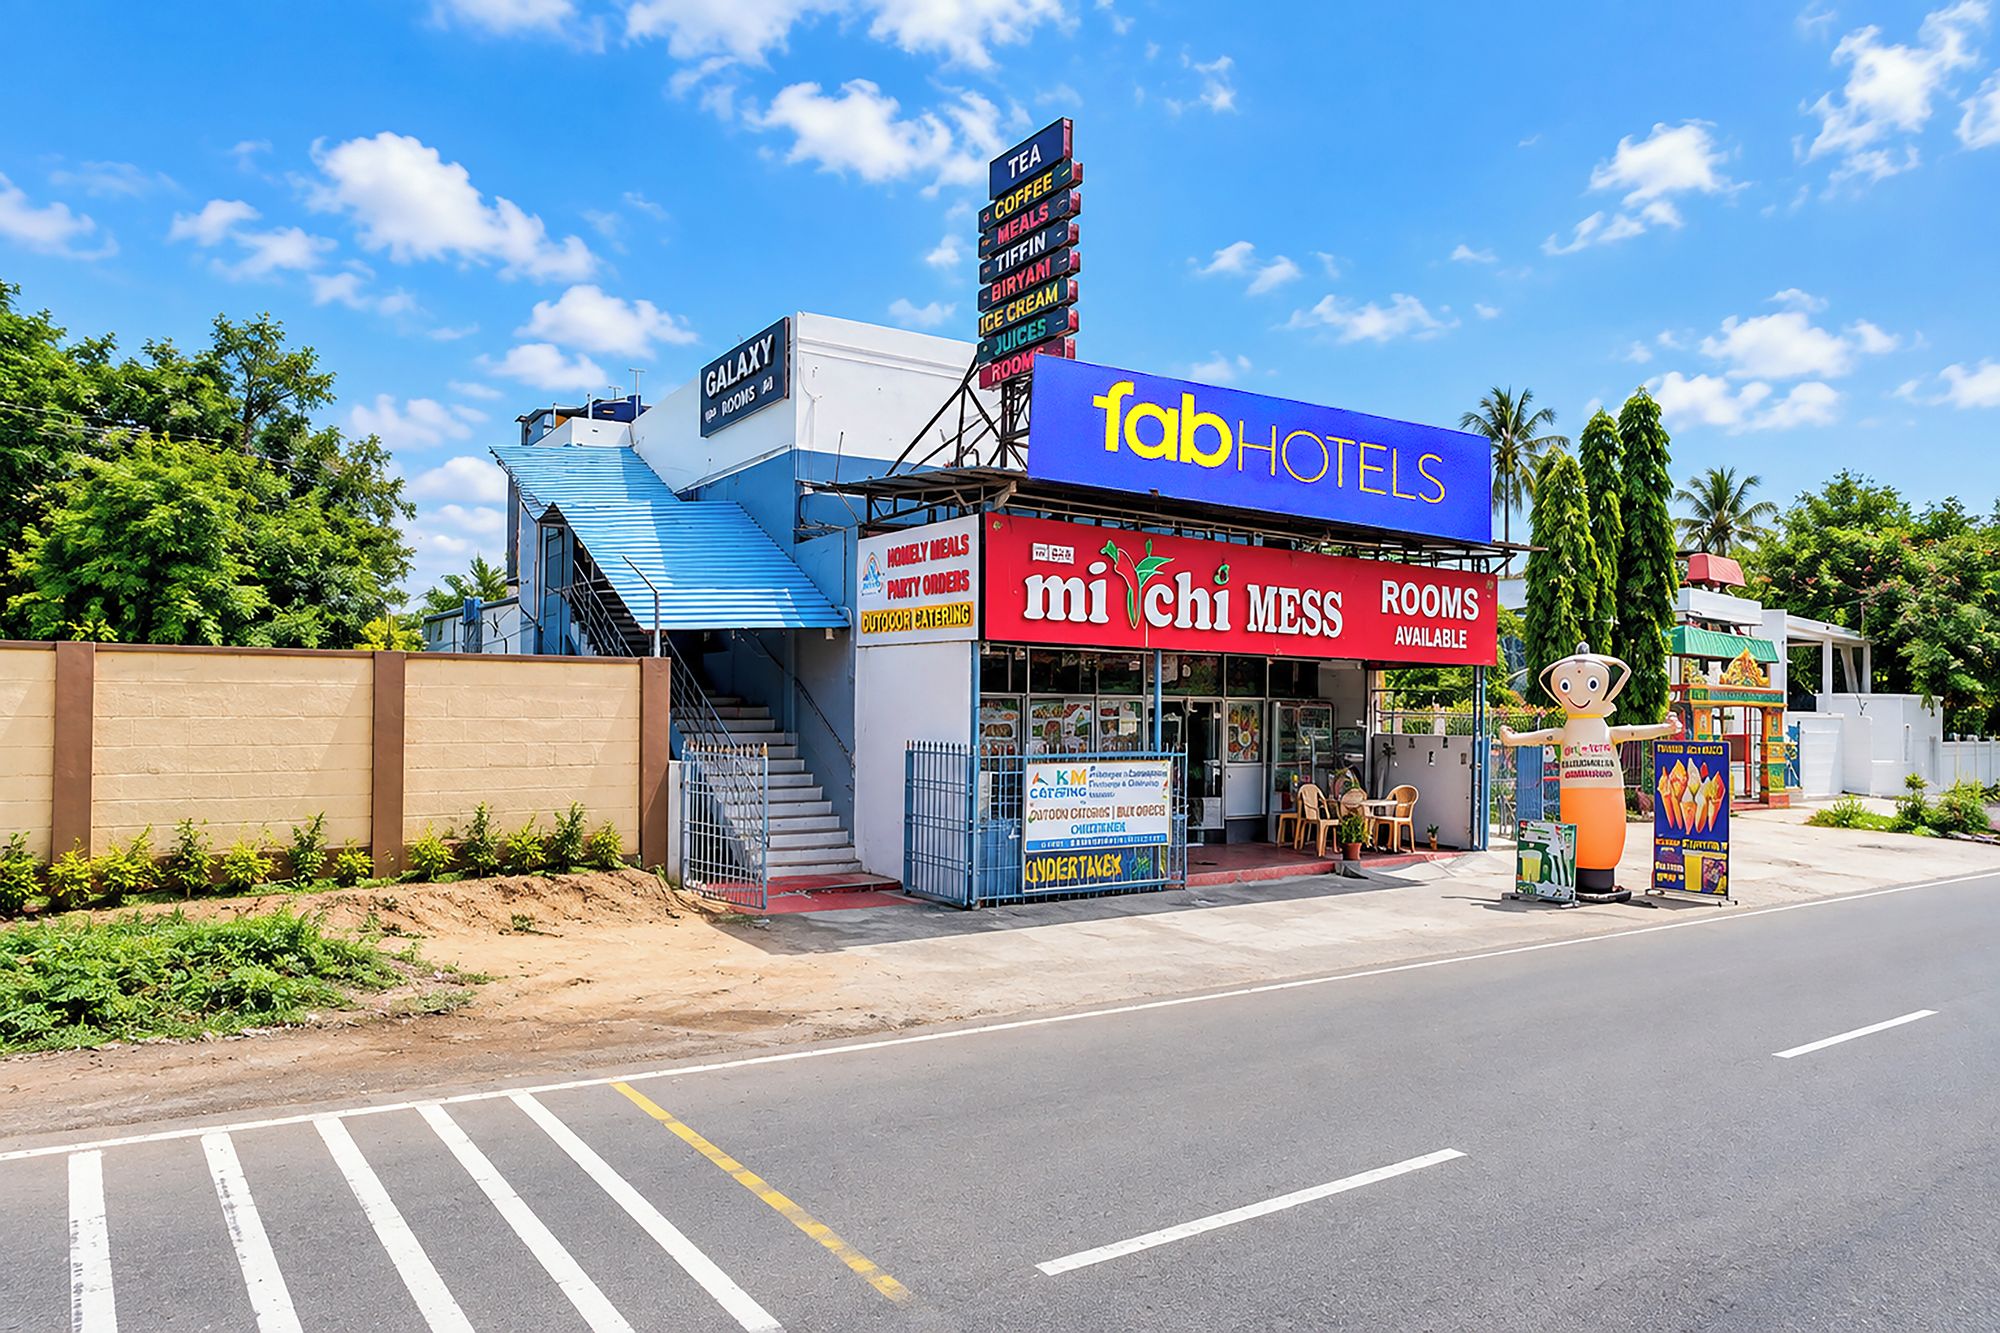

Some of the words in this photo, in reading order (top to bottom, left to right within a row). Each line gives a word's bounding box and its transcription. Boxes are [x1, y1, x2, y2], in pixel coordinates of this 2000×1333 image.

[1008, 143, 1042, 178] TEA
[994, 172, 1053, 219] COFFEE
[997, 203, 1049, 244] MEALS
[995, 231, 1047, 272] TIFFIN
[991, 258, 1051, 302] BIRYANI
[979, 308, 1004, 336] ICE
[1006, 283, 1058, 323] CREAM
[994, 318, 1047, 356] JUICES
[705, 334, 773, 398] GALAXY
[991, 346, 1044, 383] ROOM
[721, 385, 756, 416] ROOMS
[887, 541, 929, 568] HOMELY
[930, 533, 970, 561] MEALS
[887, 575, 921, 600] PARTY
[922, 569, 970, 596] ORDERS
[1381, 579, 1480, 622] ROOMS
[914, 604, 971, 629] CATERING
[1246, 583, 1344, 639] MESS
[1394, 625, 1468, 649] AVAILABLE
[1056, 768, 1087, 786] KM
